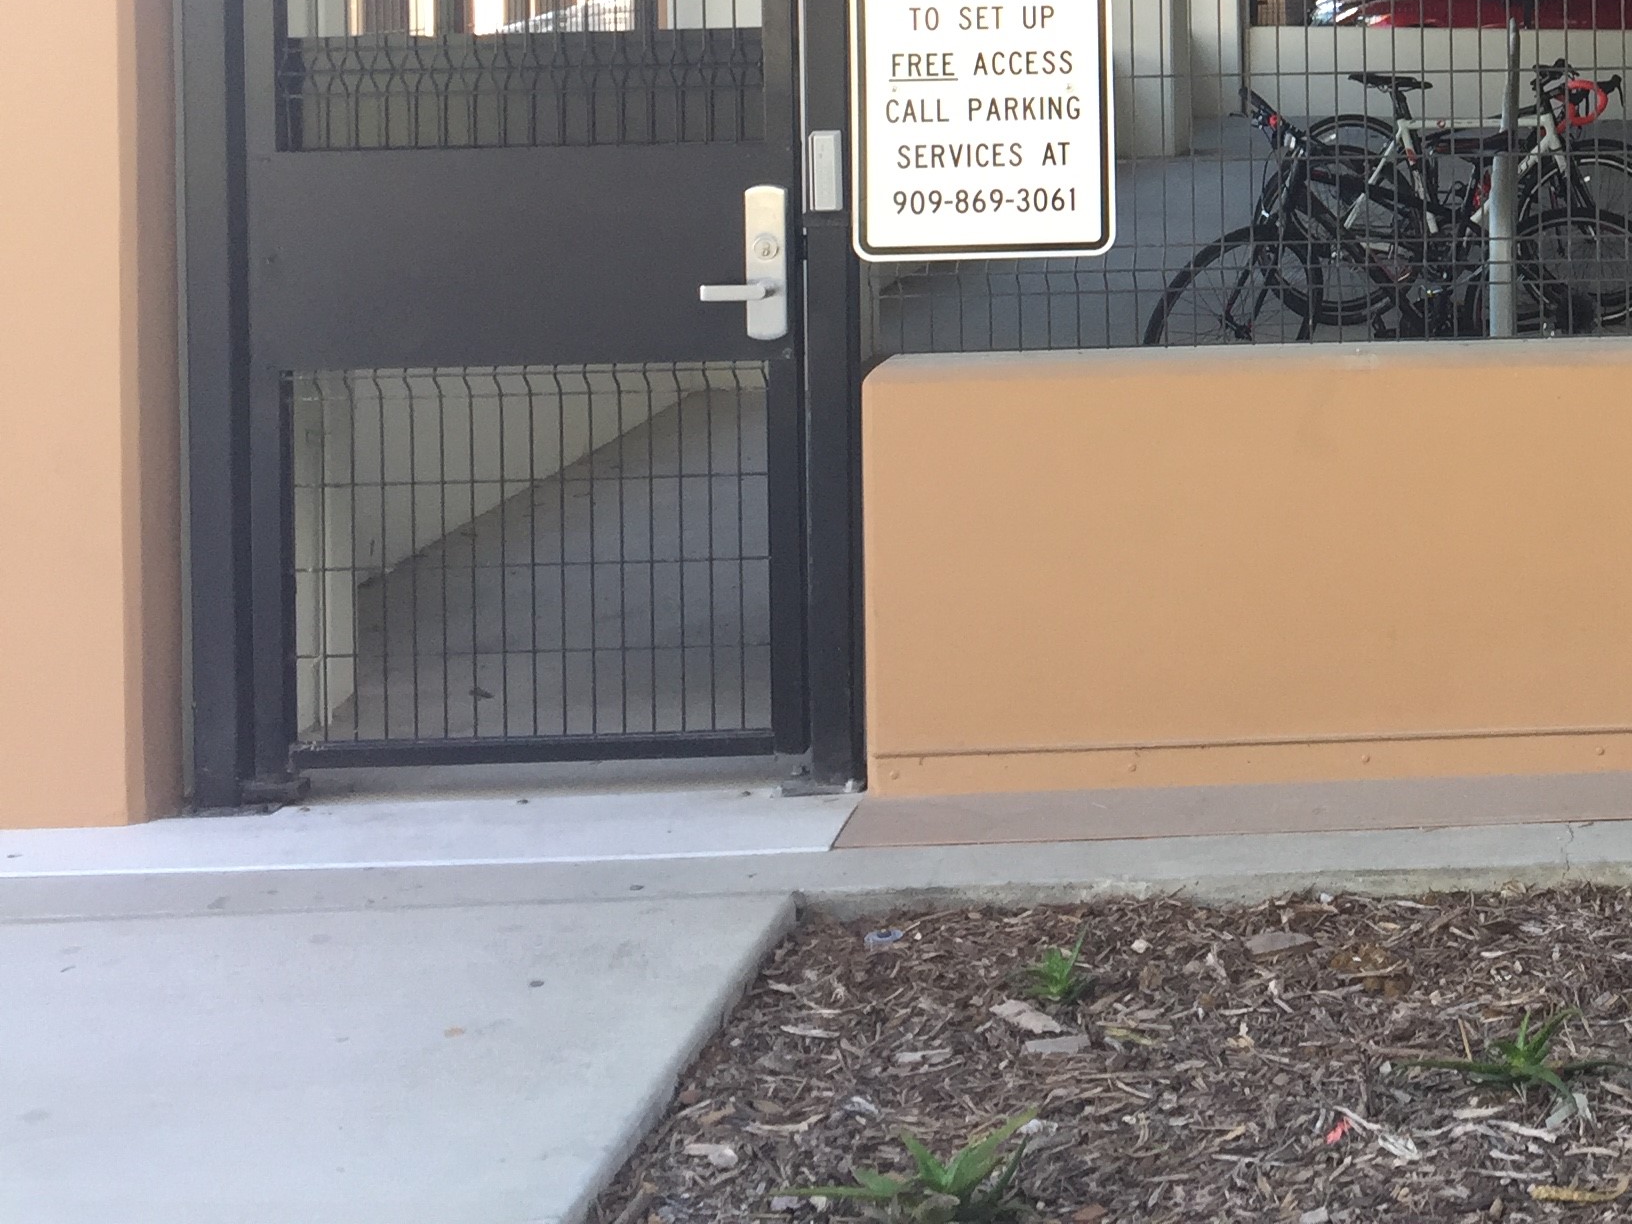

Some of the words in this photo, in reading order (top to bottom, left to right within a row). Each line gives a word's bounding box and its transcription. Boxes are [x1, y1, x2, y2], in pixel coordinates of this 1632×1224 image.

[908, 6, 939, 31] TO
[958, 5, 1004, 30] SET
[1022, 5, 1055, 30] UP
[891, 52, 955, 78] FREE
[973, 50, 1073, 76] ACCESS
[885, 98, 950, 124] CALL
[968, 95, 1081, 122] PARKING
[897, 142, 1023, 170] SERVICES
[1041, 141, 1071, 167] AT
[893, 187, 1076, 215] 909-869-3061
